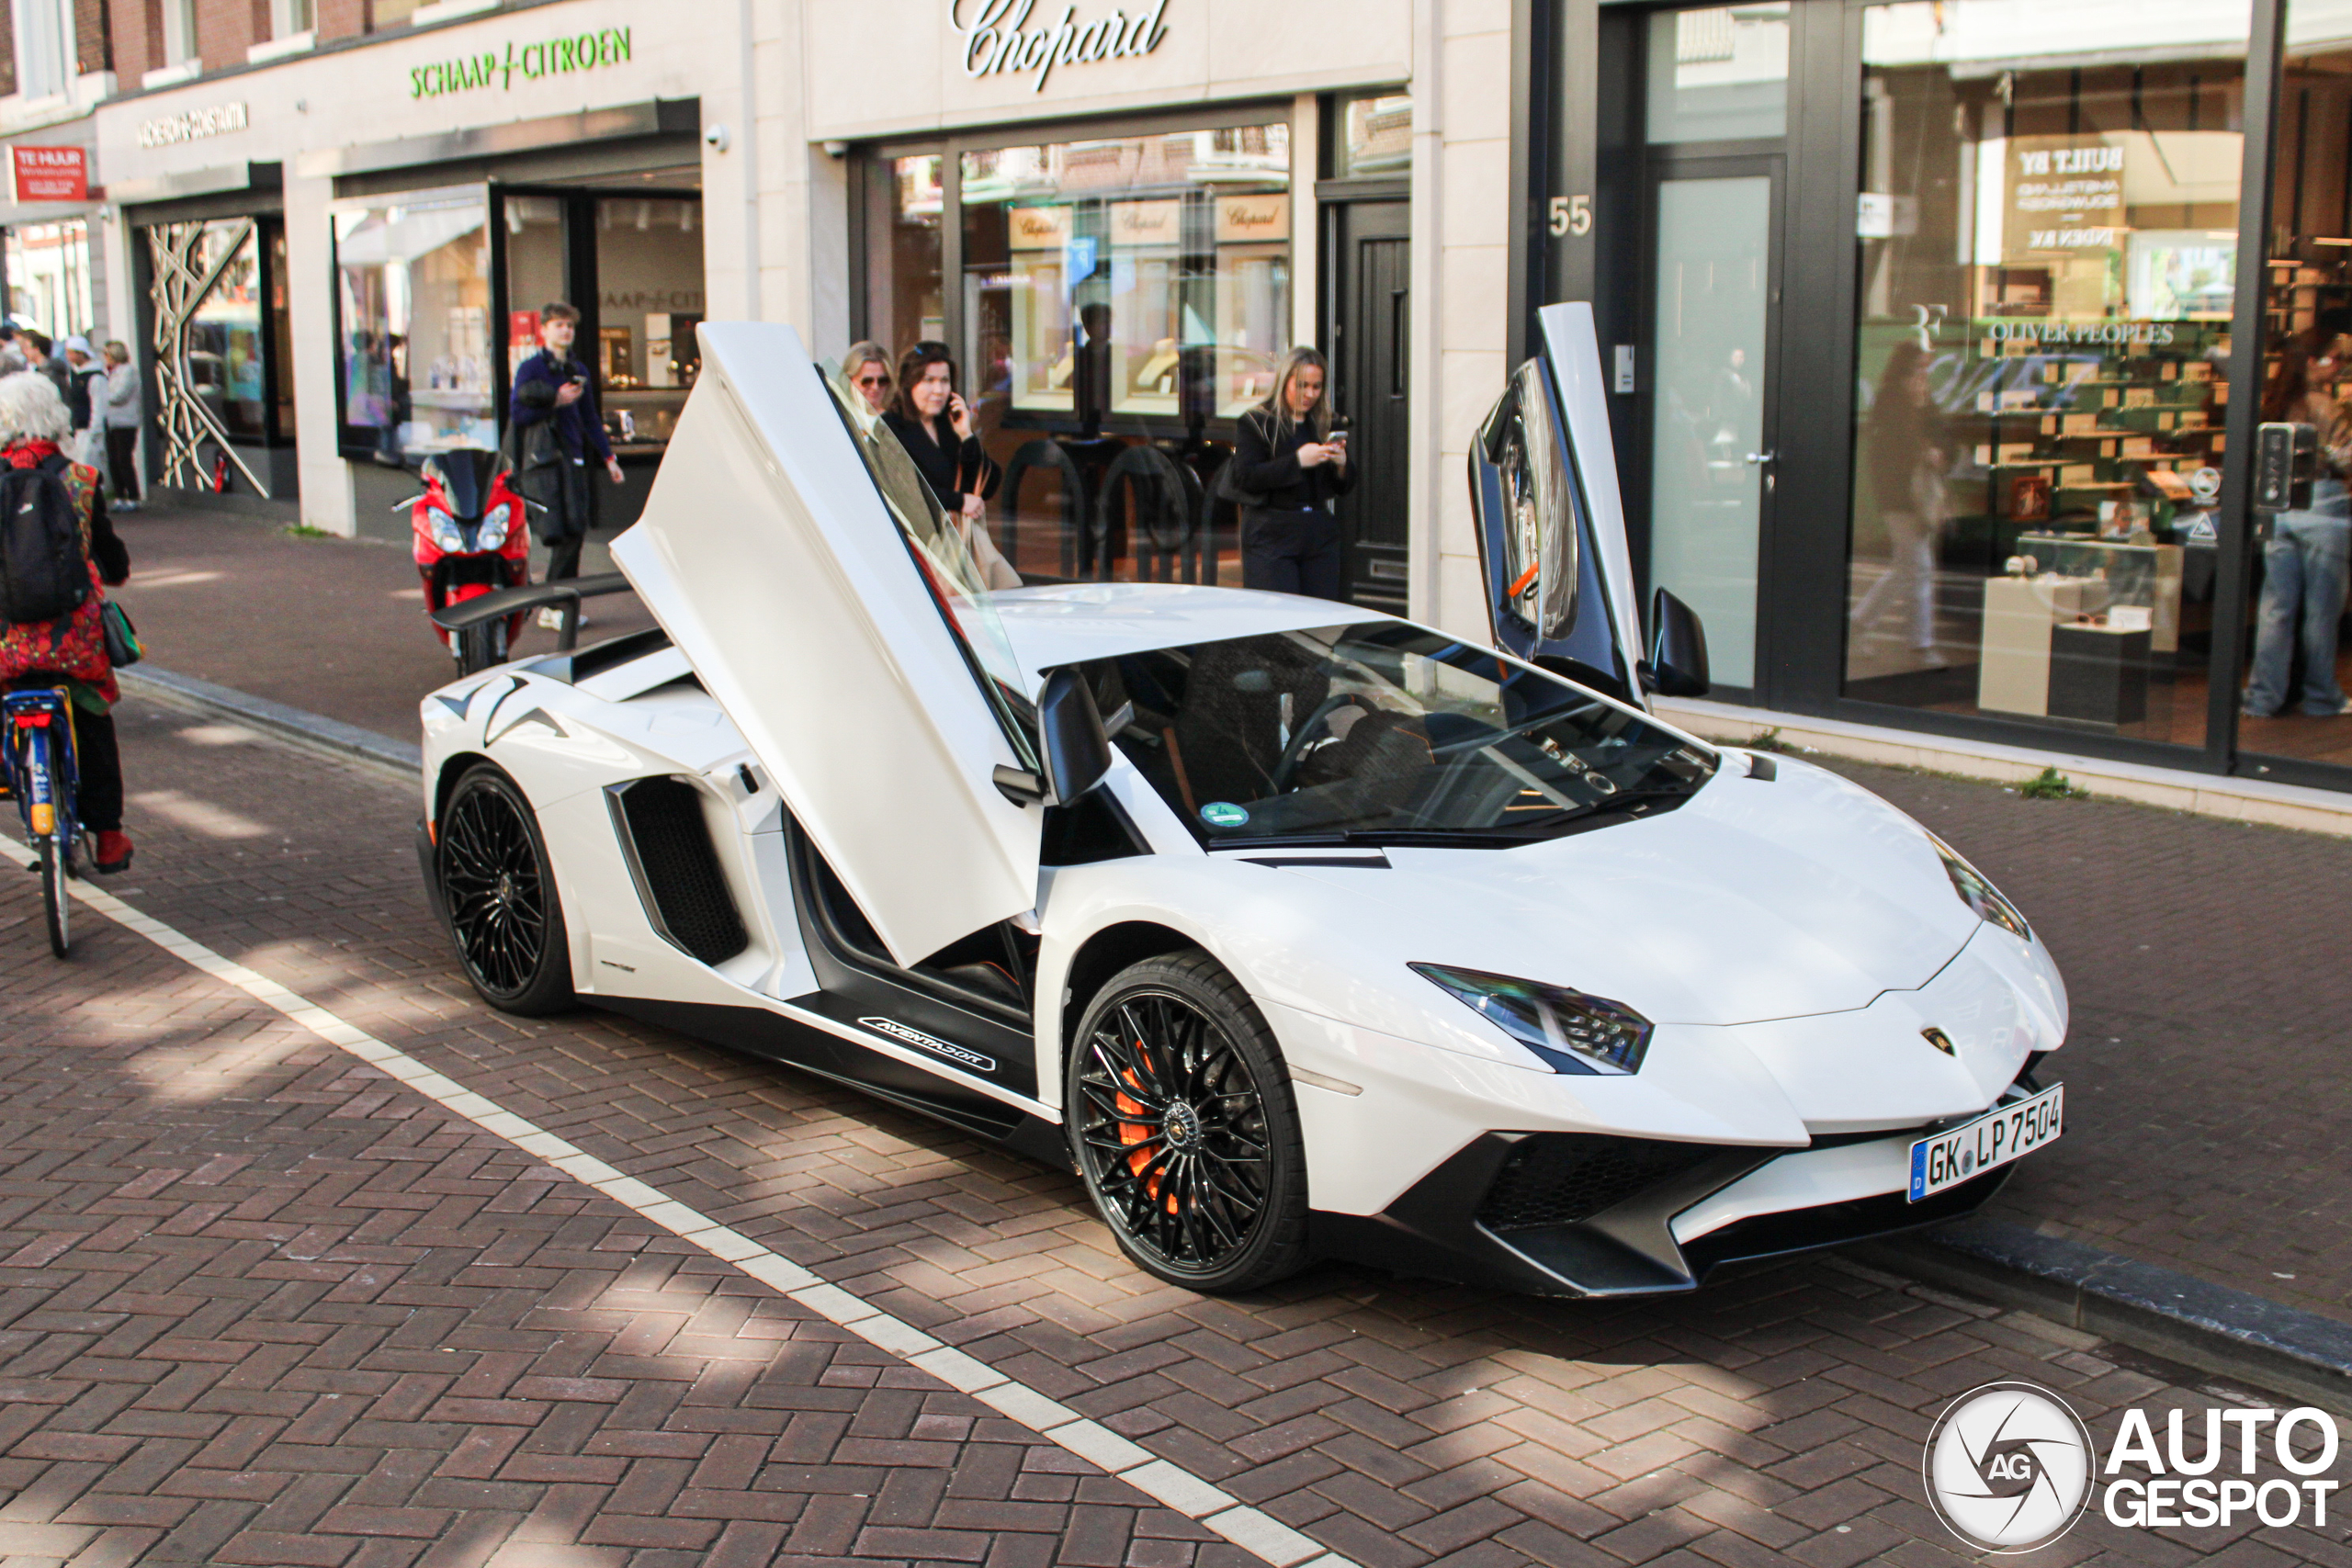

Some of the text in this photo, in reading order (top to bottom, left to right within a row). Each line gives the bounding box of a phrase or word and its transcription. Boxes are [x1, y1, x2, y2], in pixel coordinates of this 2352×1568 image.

[410, 26, 630, 99] SCHAAP CITROEN
[949, 0, 1170, 93] Chopard
[18, 150, 81, 166] TE HUUR
[1227, 204, 1280, 228] Chopard
[1549, 195, 1591, 236] 55
[1989, 322, 2175, 344] OLIVER PEOPLES
[876, 1021, 983, 1064] AVENTADOR
[1929, 1094, 2059, 1186] GK LP 7504
[1914, 1177, 1922, 1190] D
